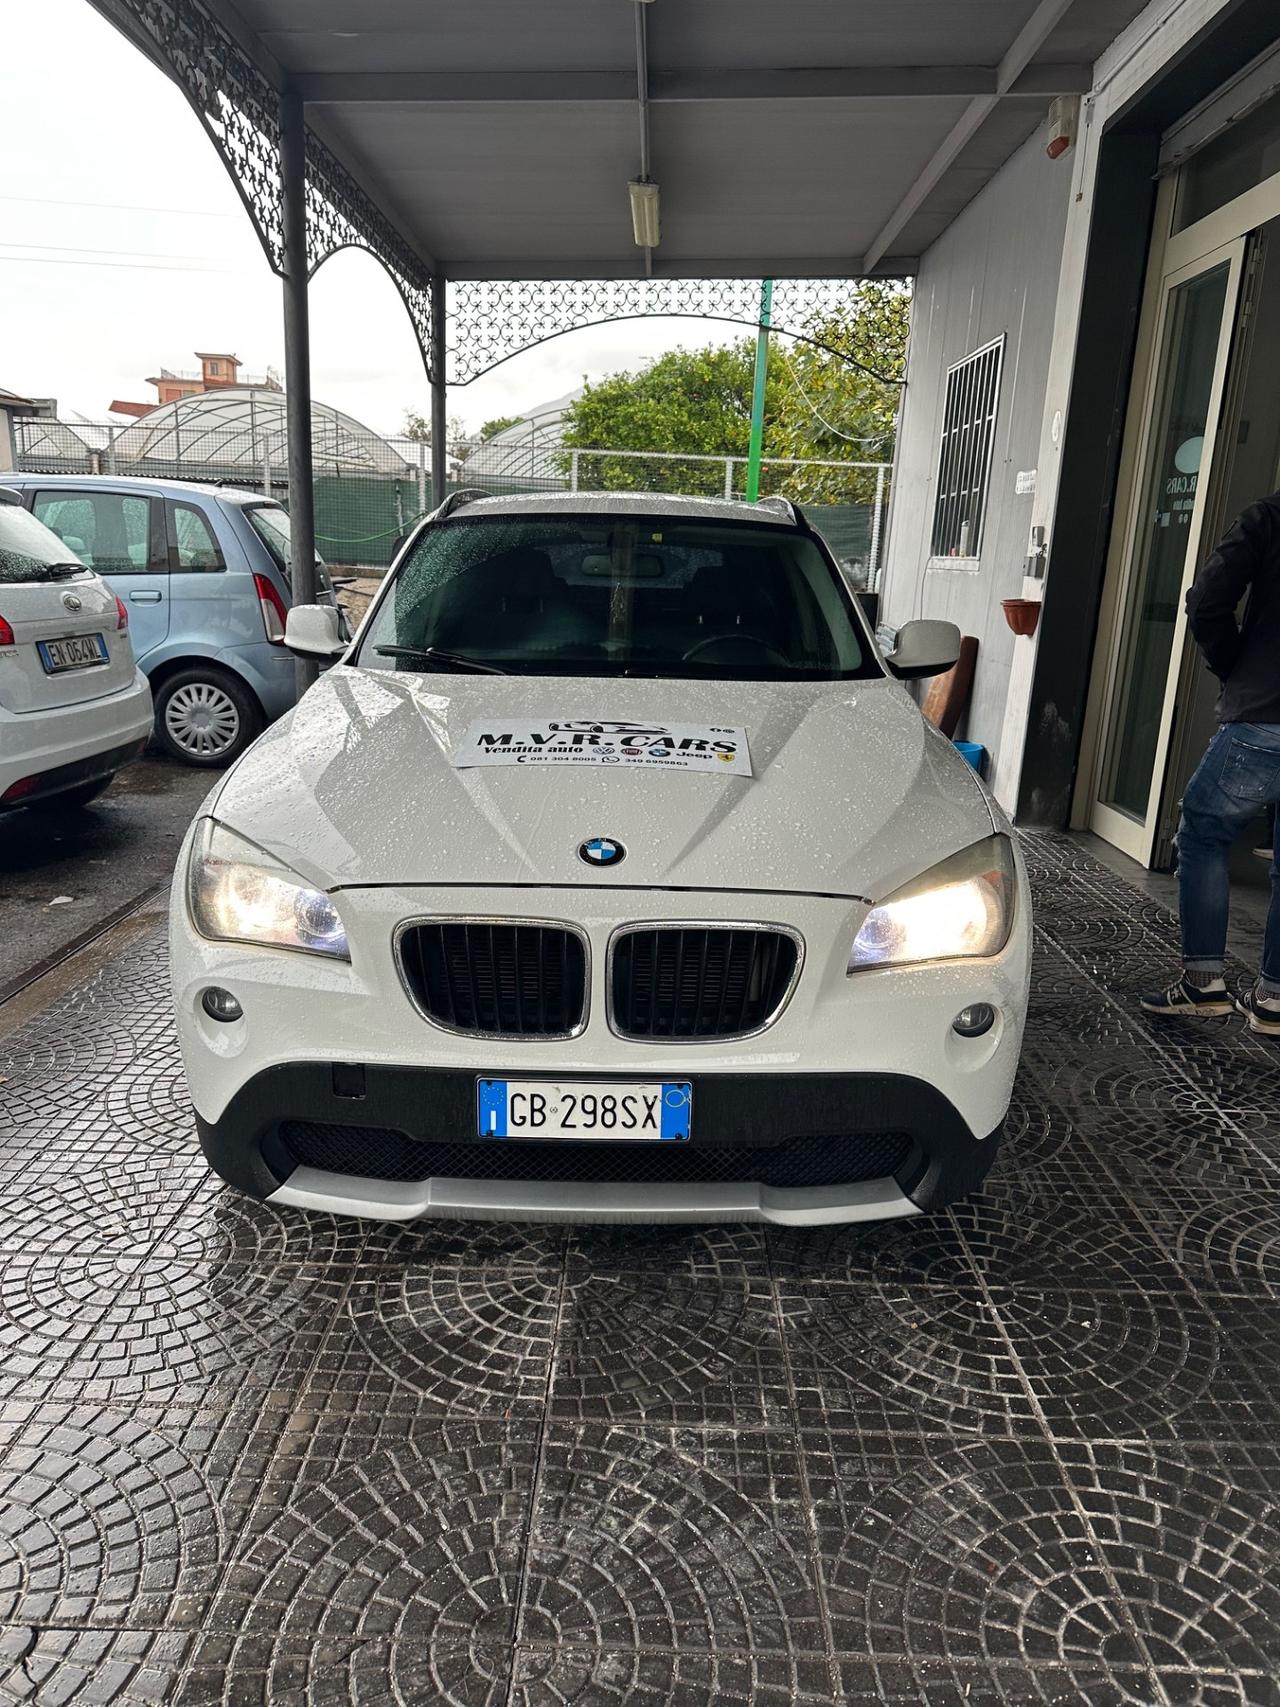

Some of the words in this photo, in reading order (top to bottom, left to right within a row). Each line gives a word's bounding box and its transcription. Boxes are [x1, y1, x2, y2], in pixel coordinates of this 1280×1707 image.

[48, 642, 66, 666] EN
[676, 751, 713, 759] Jeep
[510, 1093, 546, 1127] GB
[560, 1094, 658, 1129] 298SX
